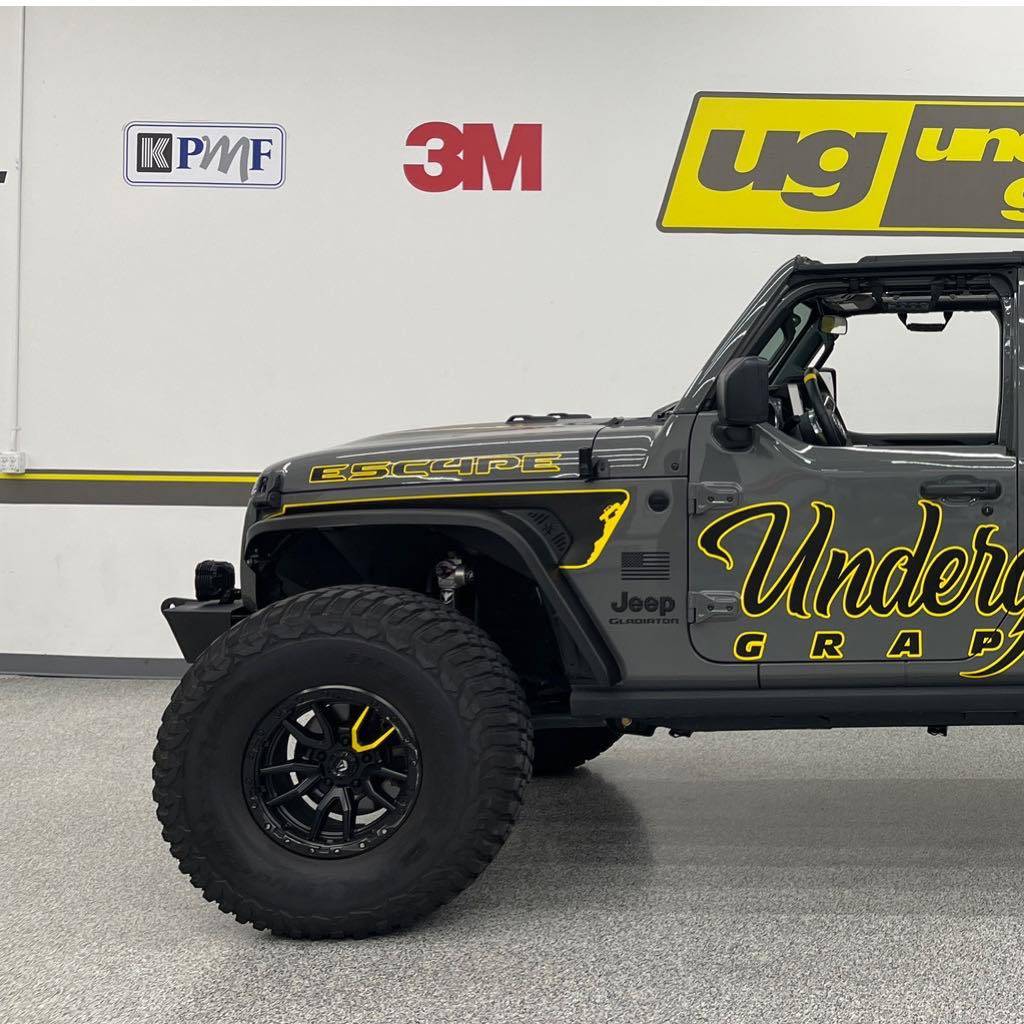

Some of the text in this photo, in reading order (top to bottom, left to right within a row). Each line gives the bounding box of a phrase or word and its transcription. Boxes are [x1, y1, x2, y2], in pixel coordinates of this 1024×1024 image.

[137, 133, 274, 183] KPMF
[403, 122, 542, 193] 3M
[696, 128, 886, 213] ug
[610, 591, 676, 617] Jeep
